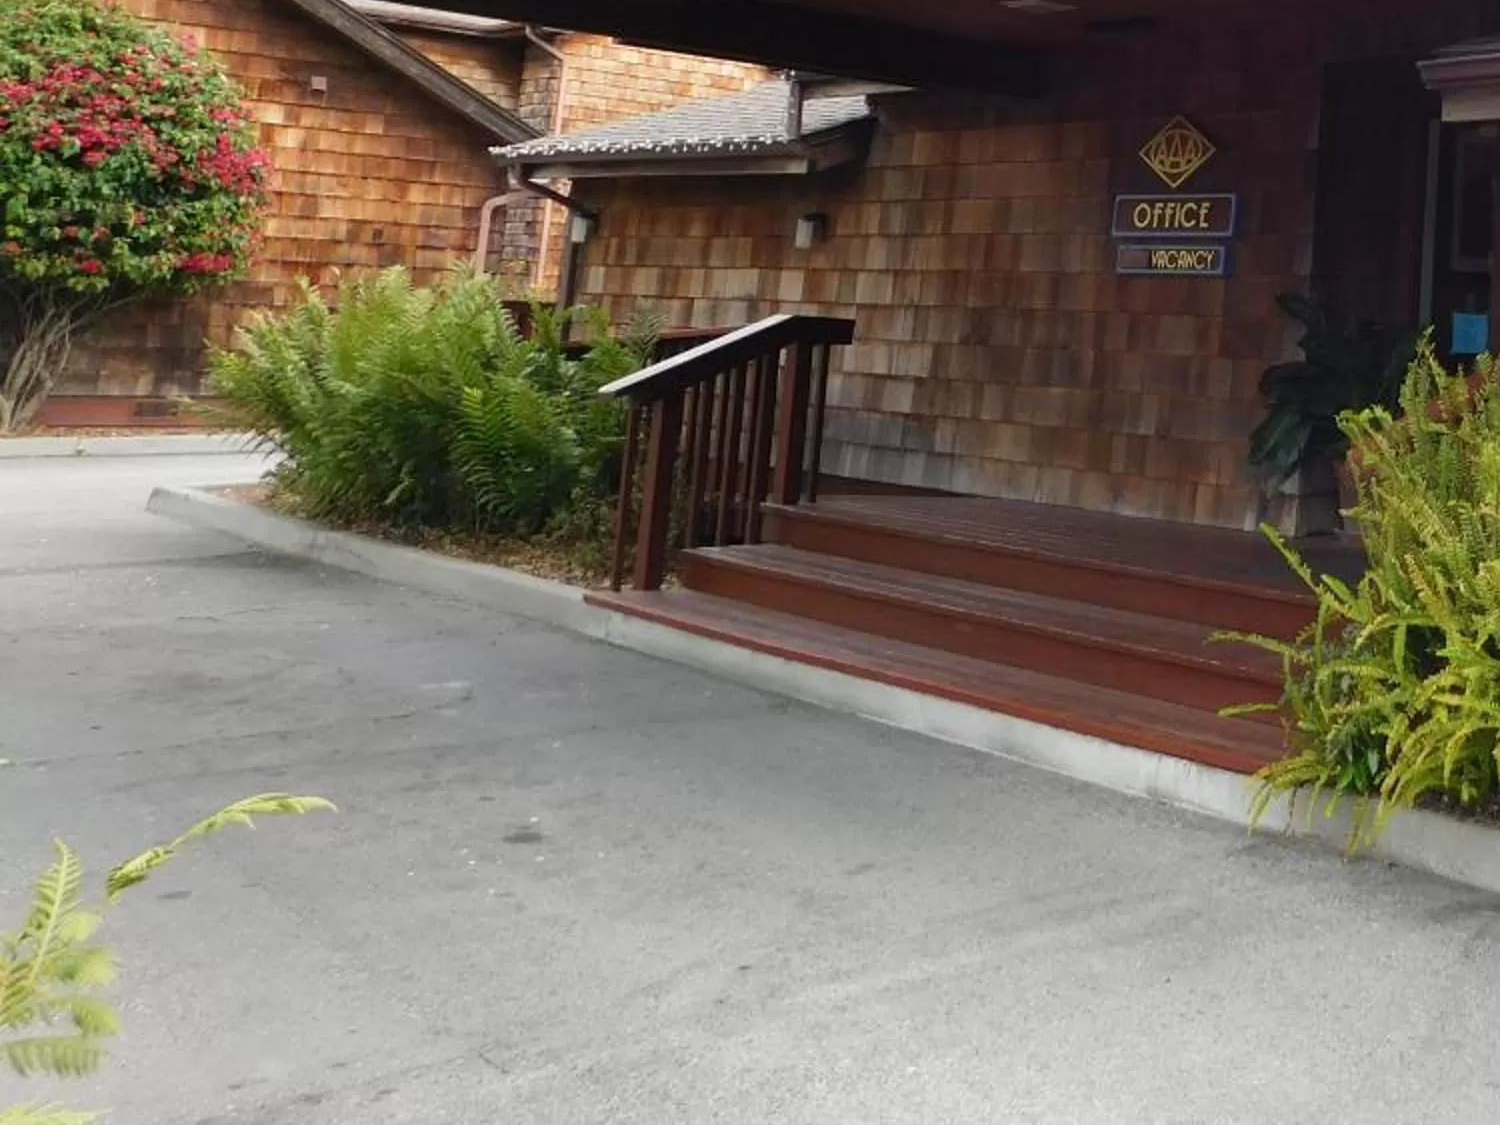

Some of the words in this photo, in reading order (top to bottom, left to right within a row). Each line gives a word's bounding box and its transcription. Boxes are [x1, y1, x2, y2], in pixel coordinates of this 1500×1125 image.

[1153, 131, 1198, 170] AAA
[1133, 202, 1211, 229] OFFICE
[1150, 250, 1215, 270] VACANCY
